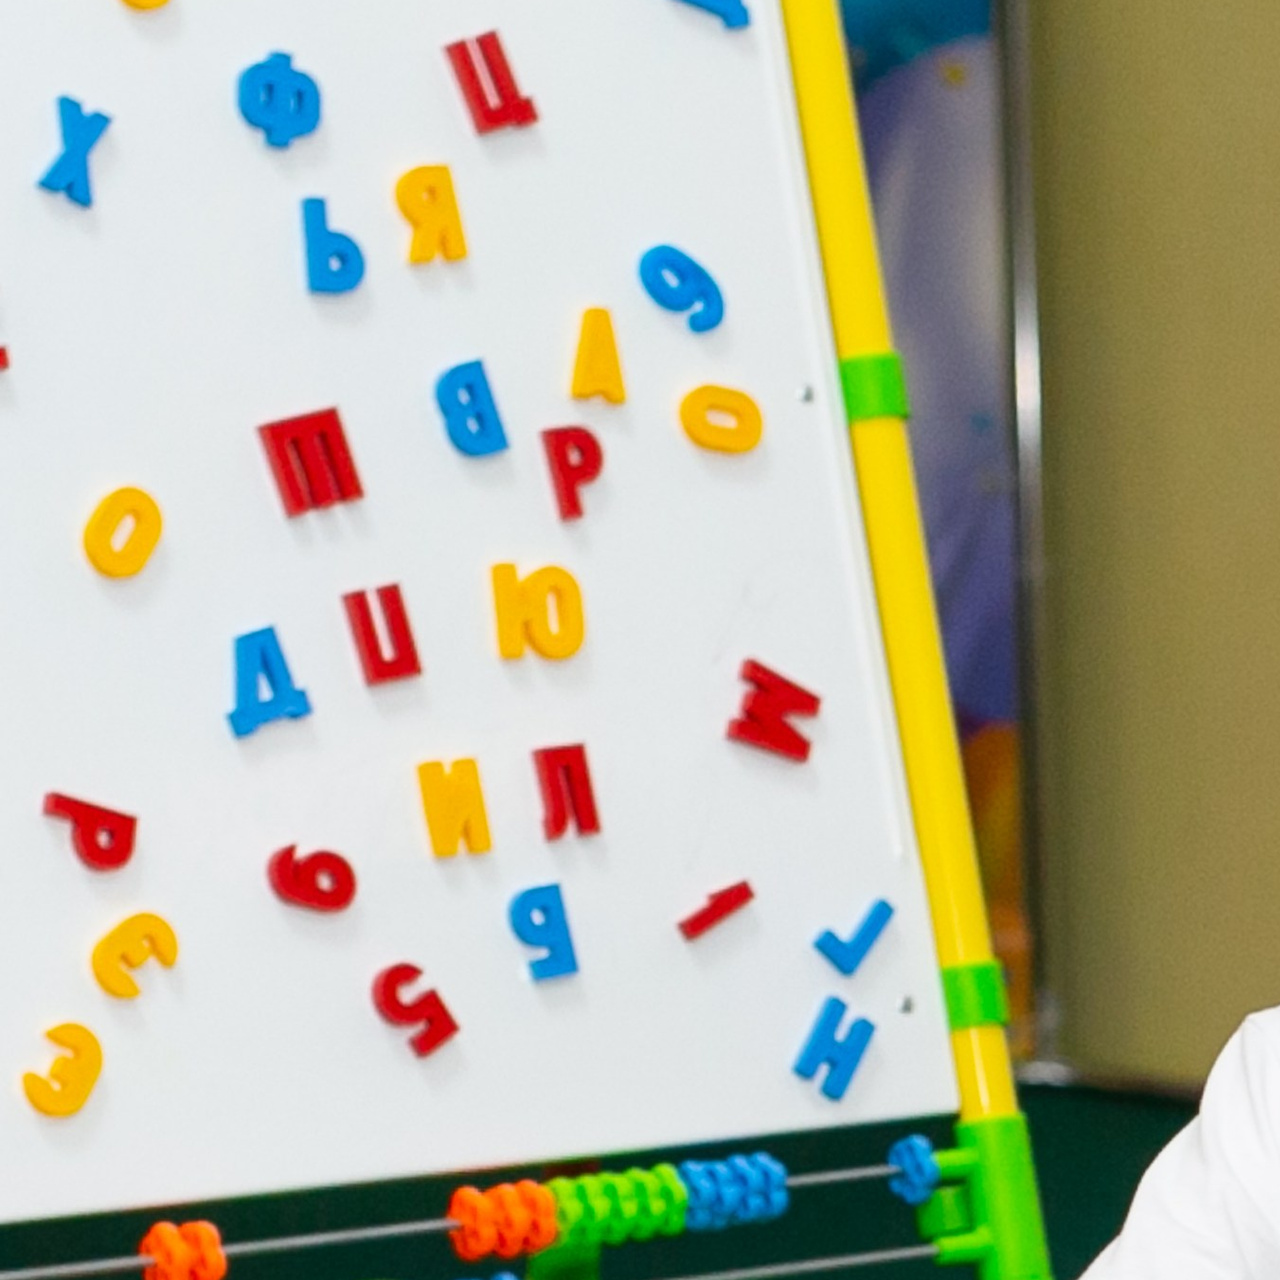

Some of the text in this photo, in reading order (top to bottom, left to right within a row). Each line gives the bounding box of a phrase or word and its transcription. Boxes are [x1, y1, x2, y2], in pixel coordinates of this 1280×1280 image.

[237, 51, 321, 150] Ф
[446, 31, 539, 136] Ц
[37, 95, 112, 209] Х
[395, 164, 468, 265] Я
[491, 562, 586, 662] Ю
[226, 625, 312, 739] Д
